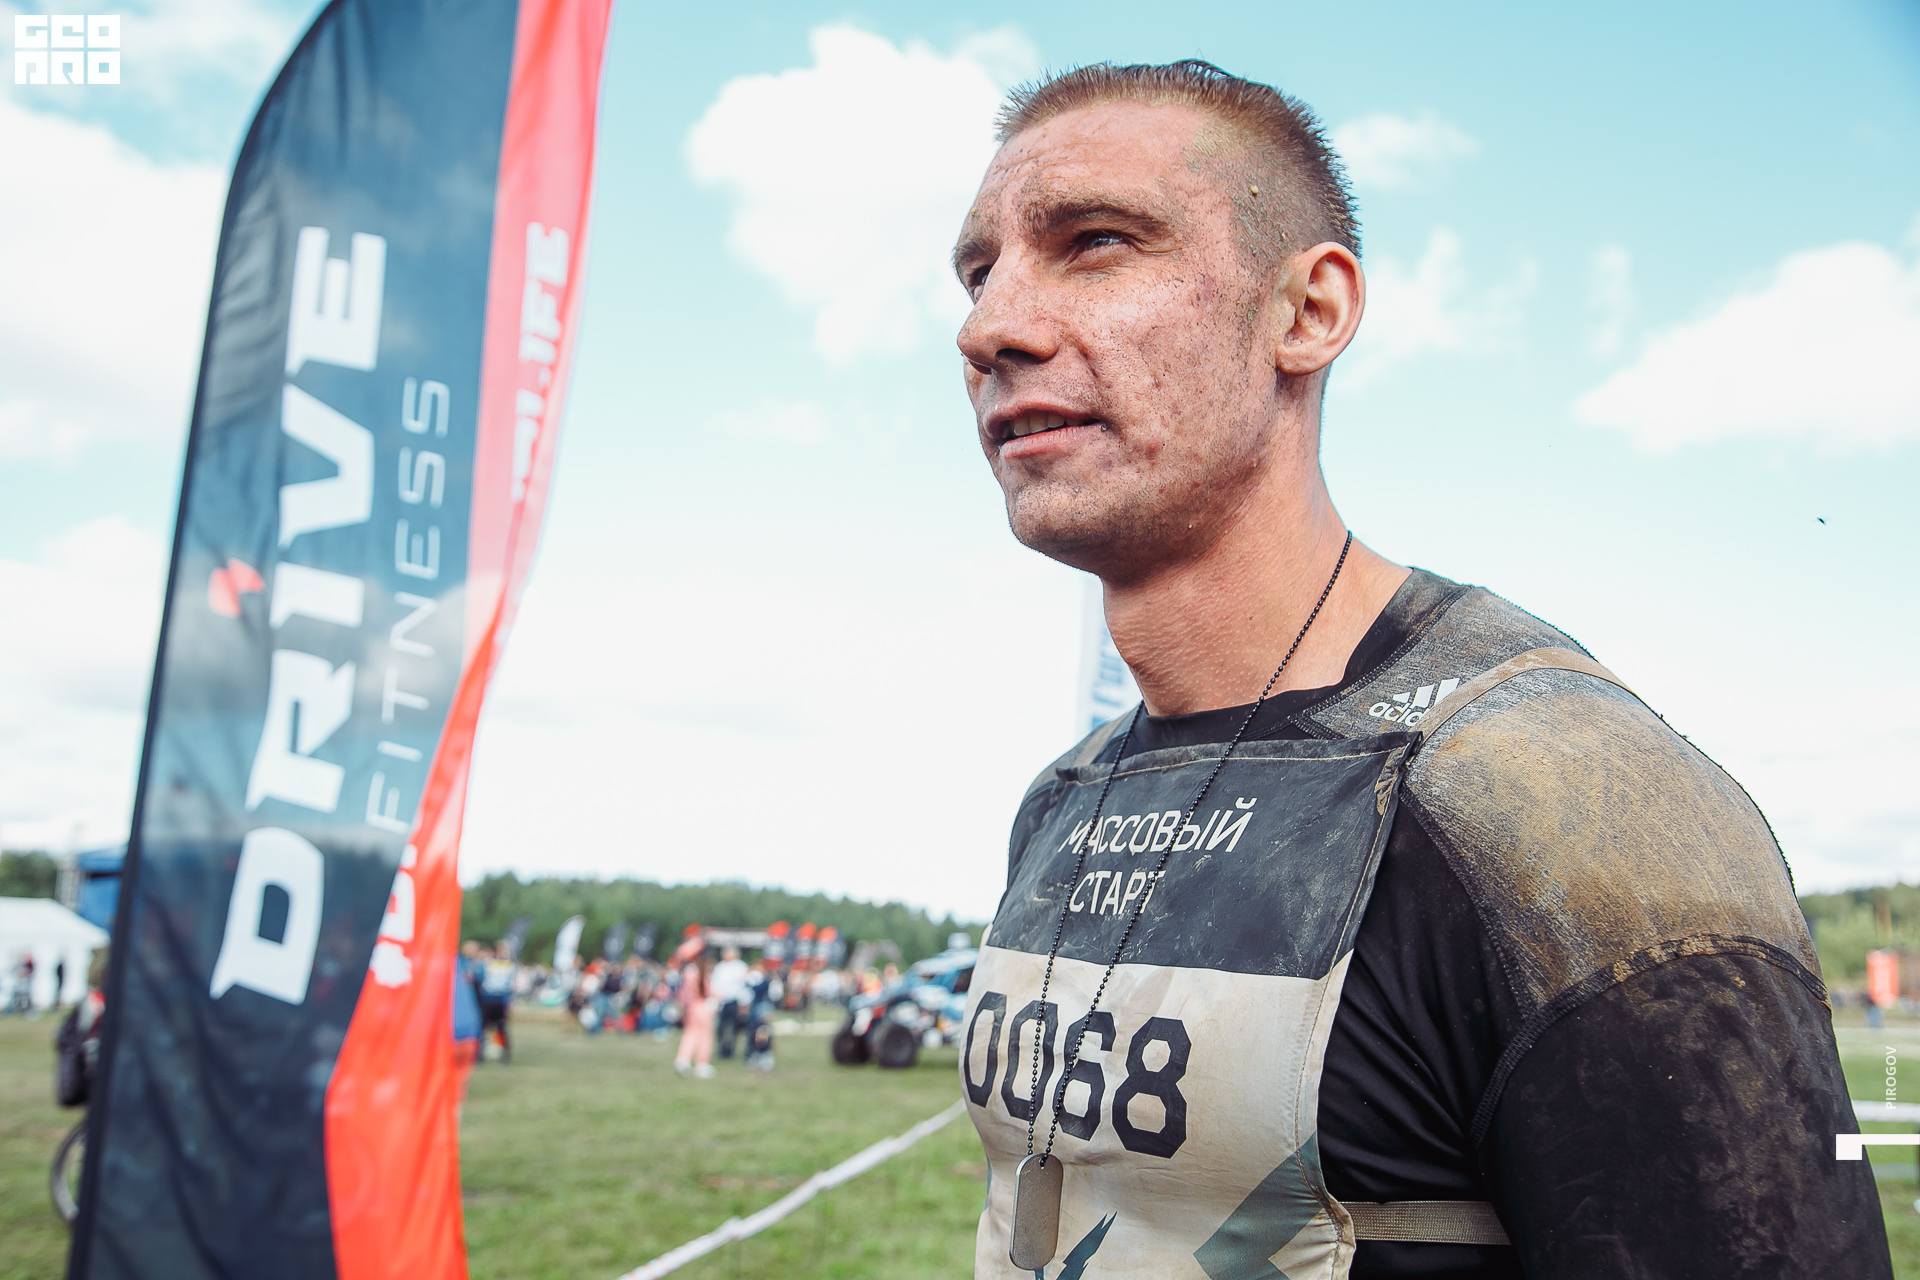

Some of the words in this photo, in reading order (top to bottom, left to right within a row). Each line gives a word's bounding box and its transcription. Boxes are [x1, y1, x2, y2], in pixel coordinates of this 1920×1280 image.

[208, 226, 387, 1004] DRIVE
[364, 376, 450, 833] FITNESS
[1368, 702, 1431, 727] adid
[1057, 797, 1258, 856] МАССОВЫЙ
[1069, 869, 1166, 915] СТАРТ
[964, 991, 1192, 1159] 0068
